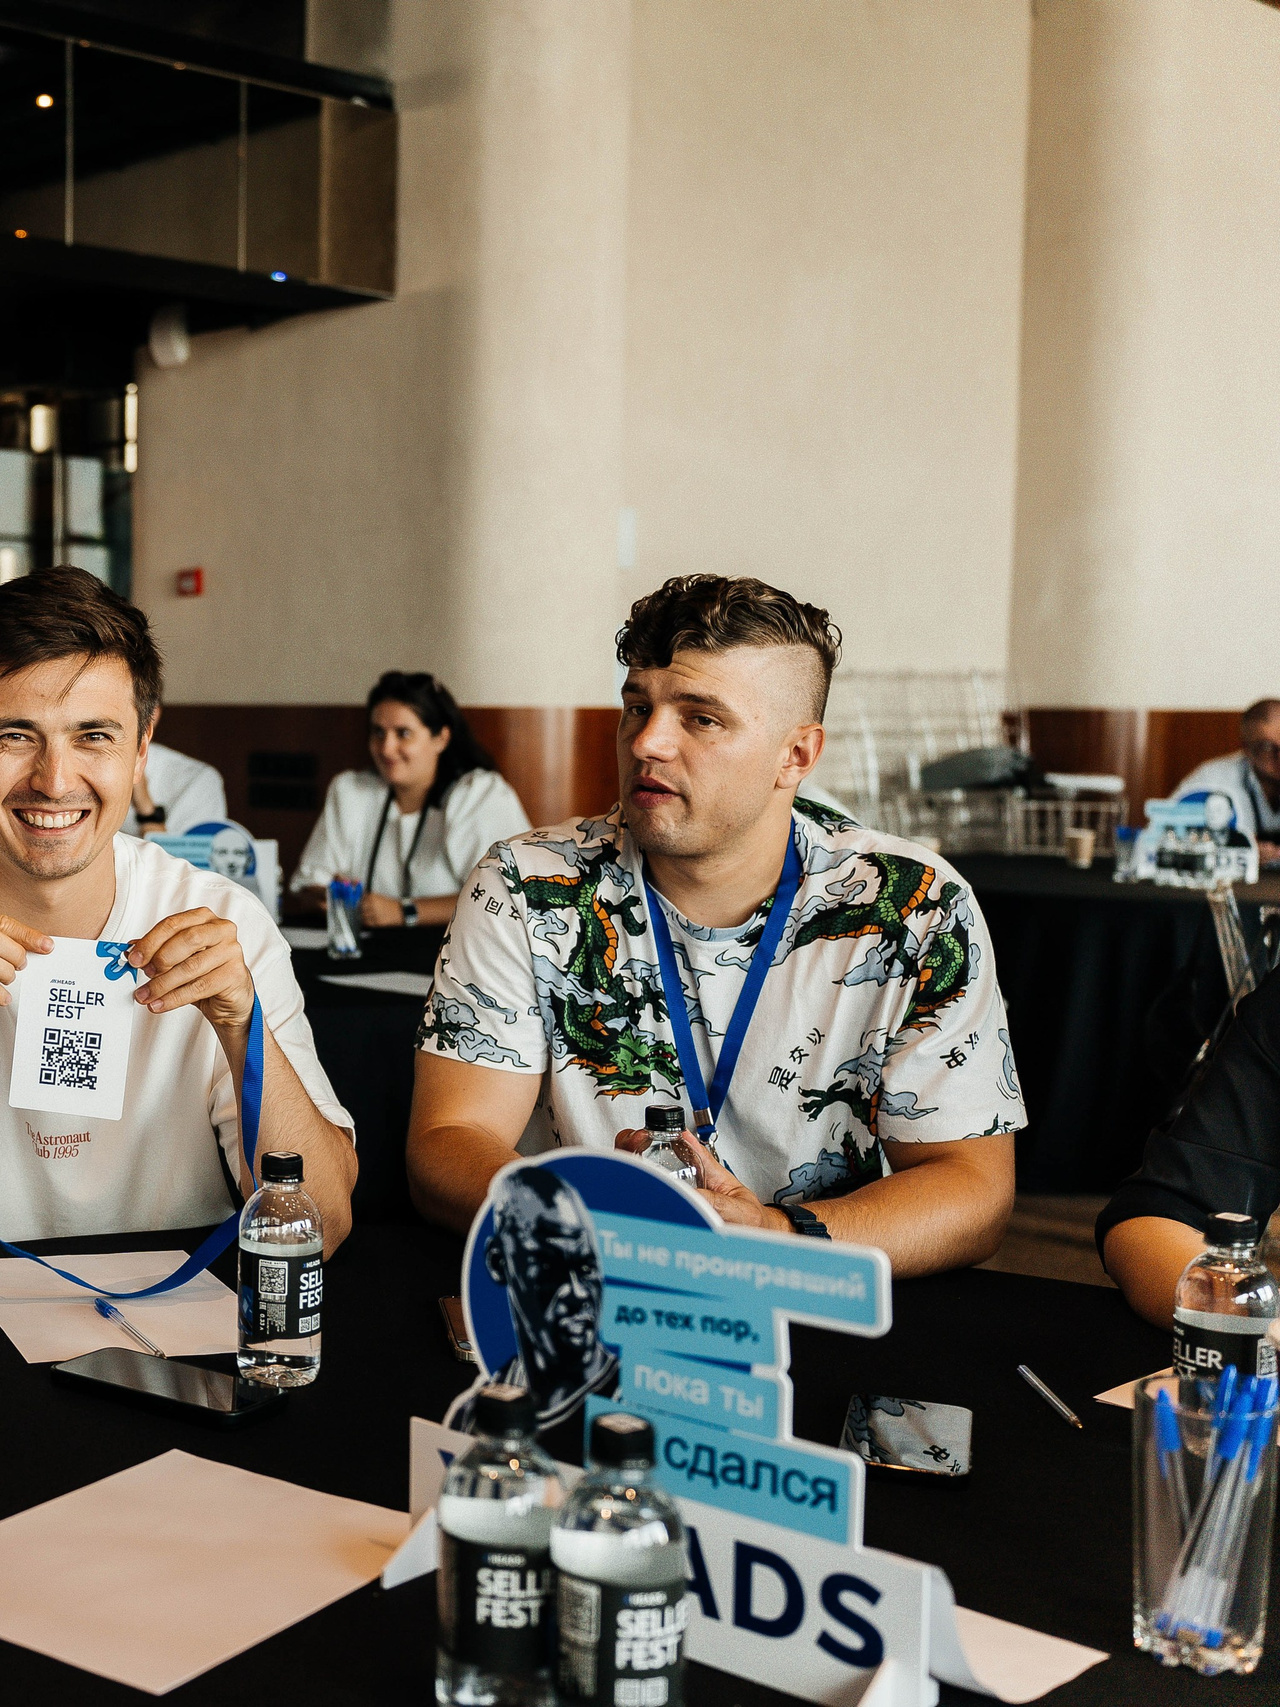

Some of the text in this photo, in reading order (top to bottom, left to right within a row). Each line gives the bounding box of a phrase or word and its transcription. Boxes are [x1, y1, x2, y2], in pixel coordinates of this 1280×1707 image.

[47, 1003, 86, 1020] FEST
[49, 988, 105, 1007] SELLER
[35, 1131, 91, 1146] Astronaut
[52, 1144, 80, 1160] 1995
[600, 1229, 867, 1300] Ты не проигравший
[614, 1304, 647, 1327] до
[651, 1309, 695, 1332] тех
[633, 1364, 764, 1421] пока ты
[664, 1436, 838, 1513] сдался
[476, 1596, 545, 1628] FEST
[615, 1635, 683, 1671] FEST
